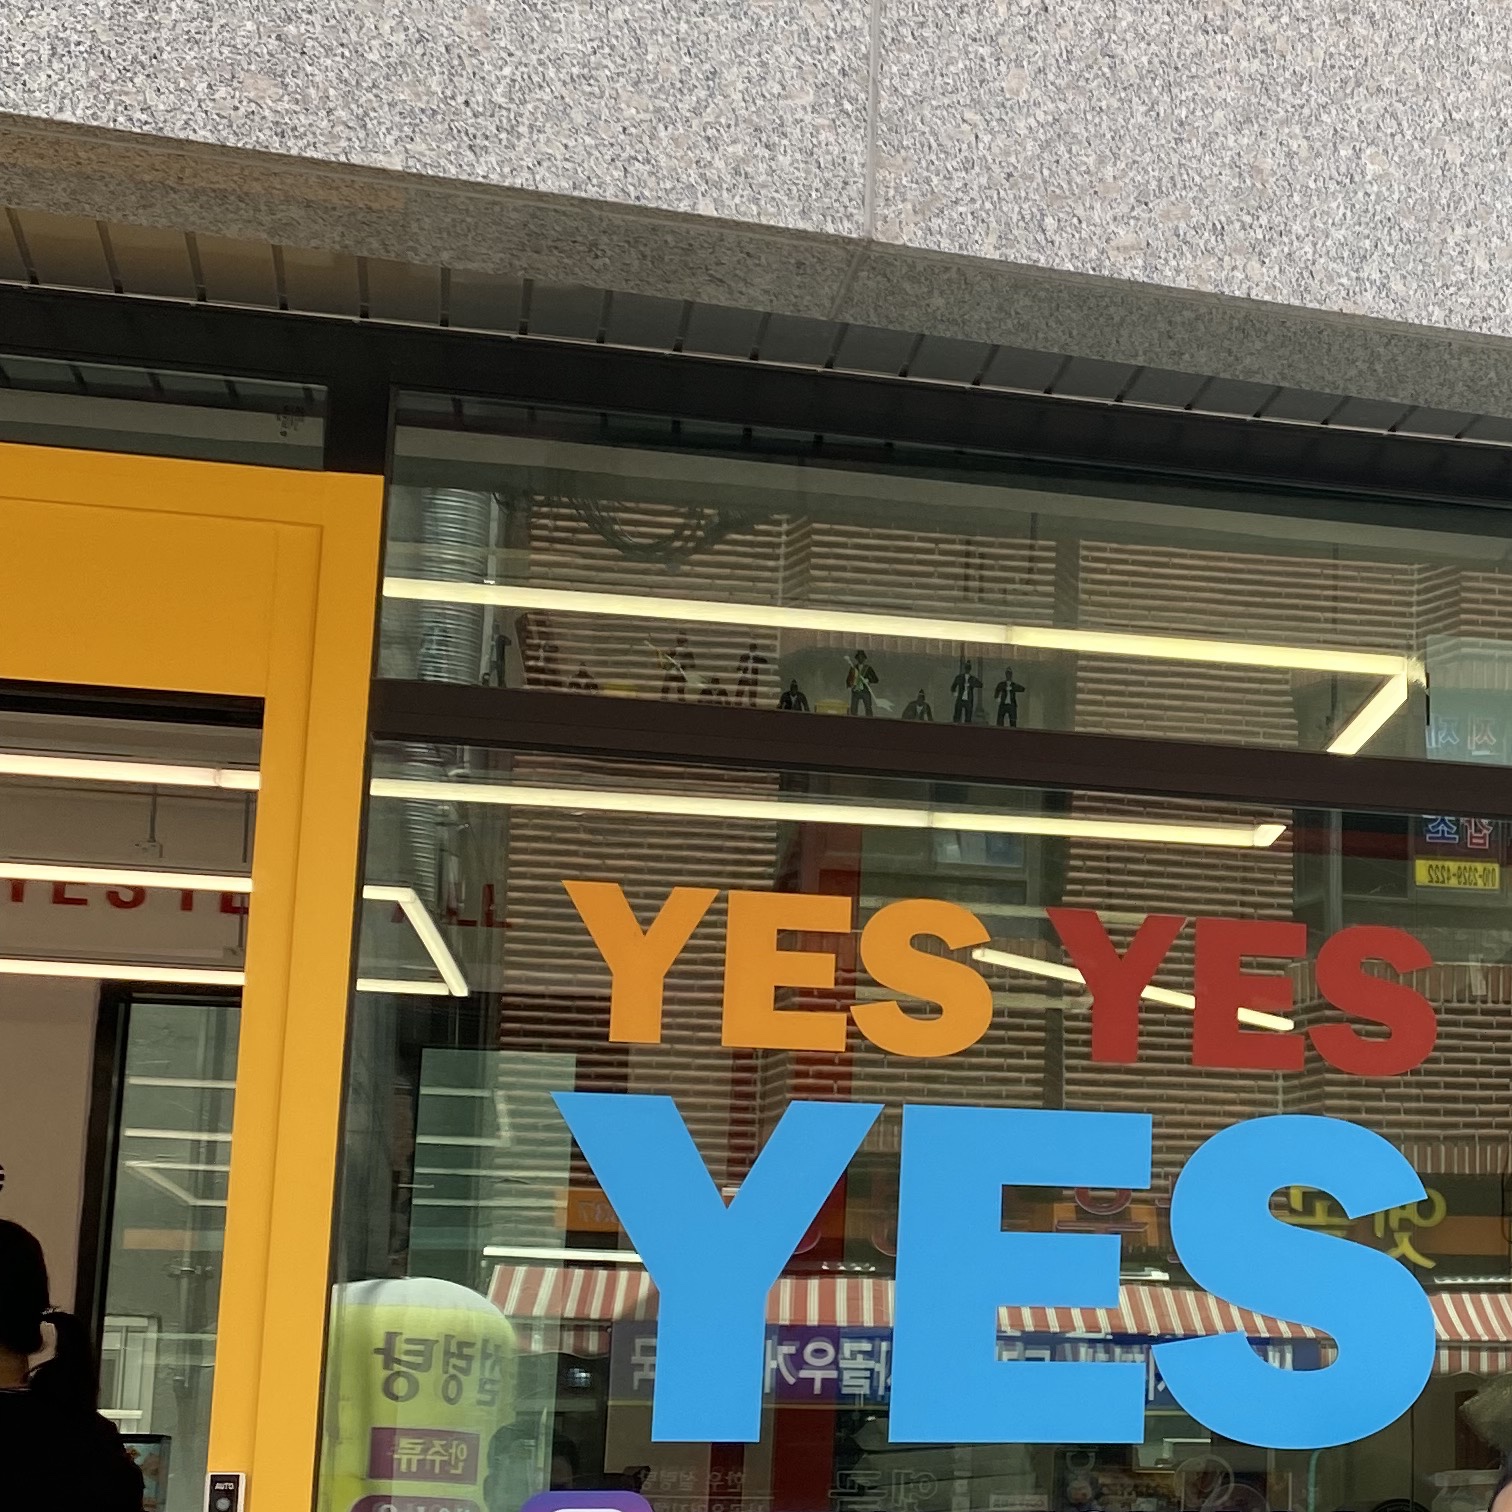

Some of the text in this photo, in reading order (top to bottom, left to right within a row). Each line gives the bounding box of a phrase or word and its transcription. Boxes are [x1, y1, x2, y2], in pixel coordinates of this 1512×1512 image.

[562, 880, 1439, 1078] YES YES
[552, 1091, 1438, 1451] YES
[214, 1481, 235, 1490] AUTO
